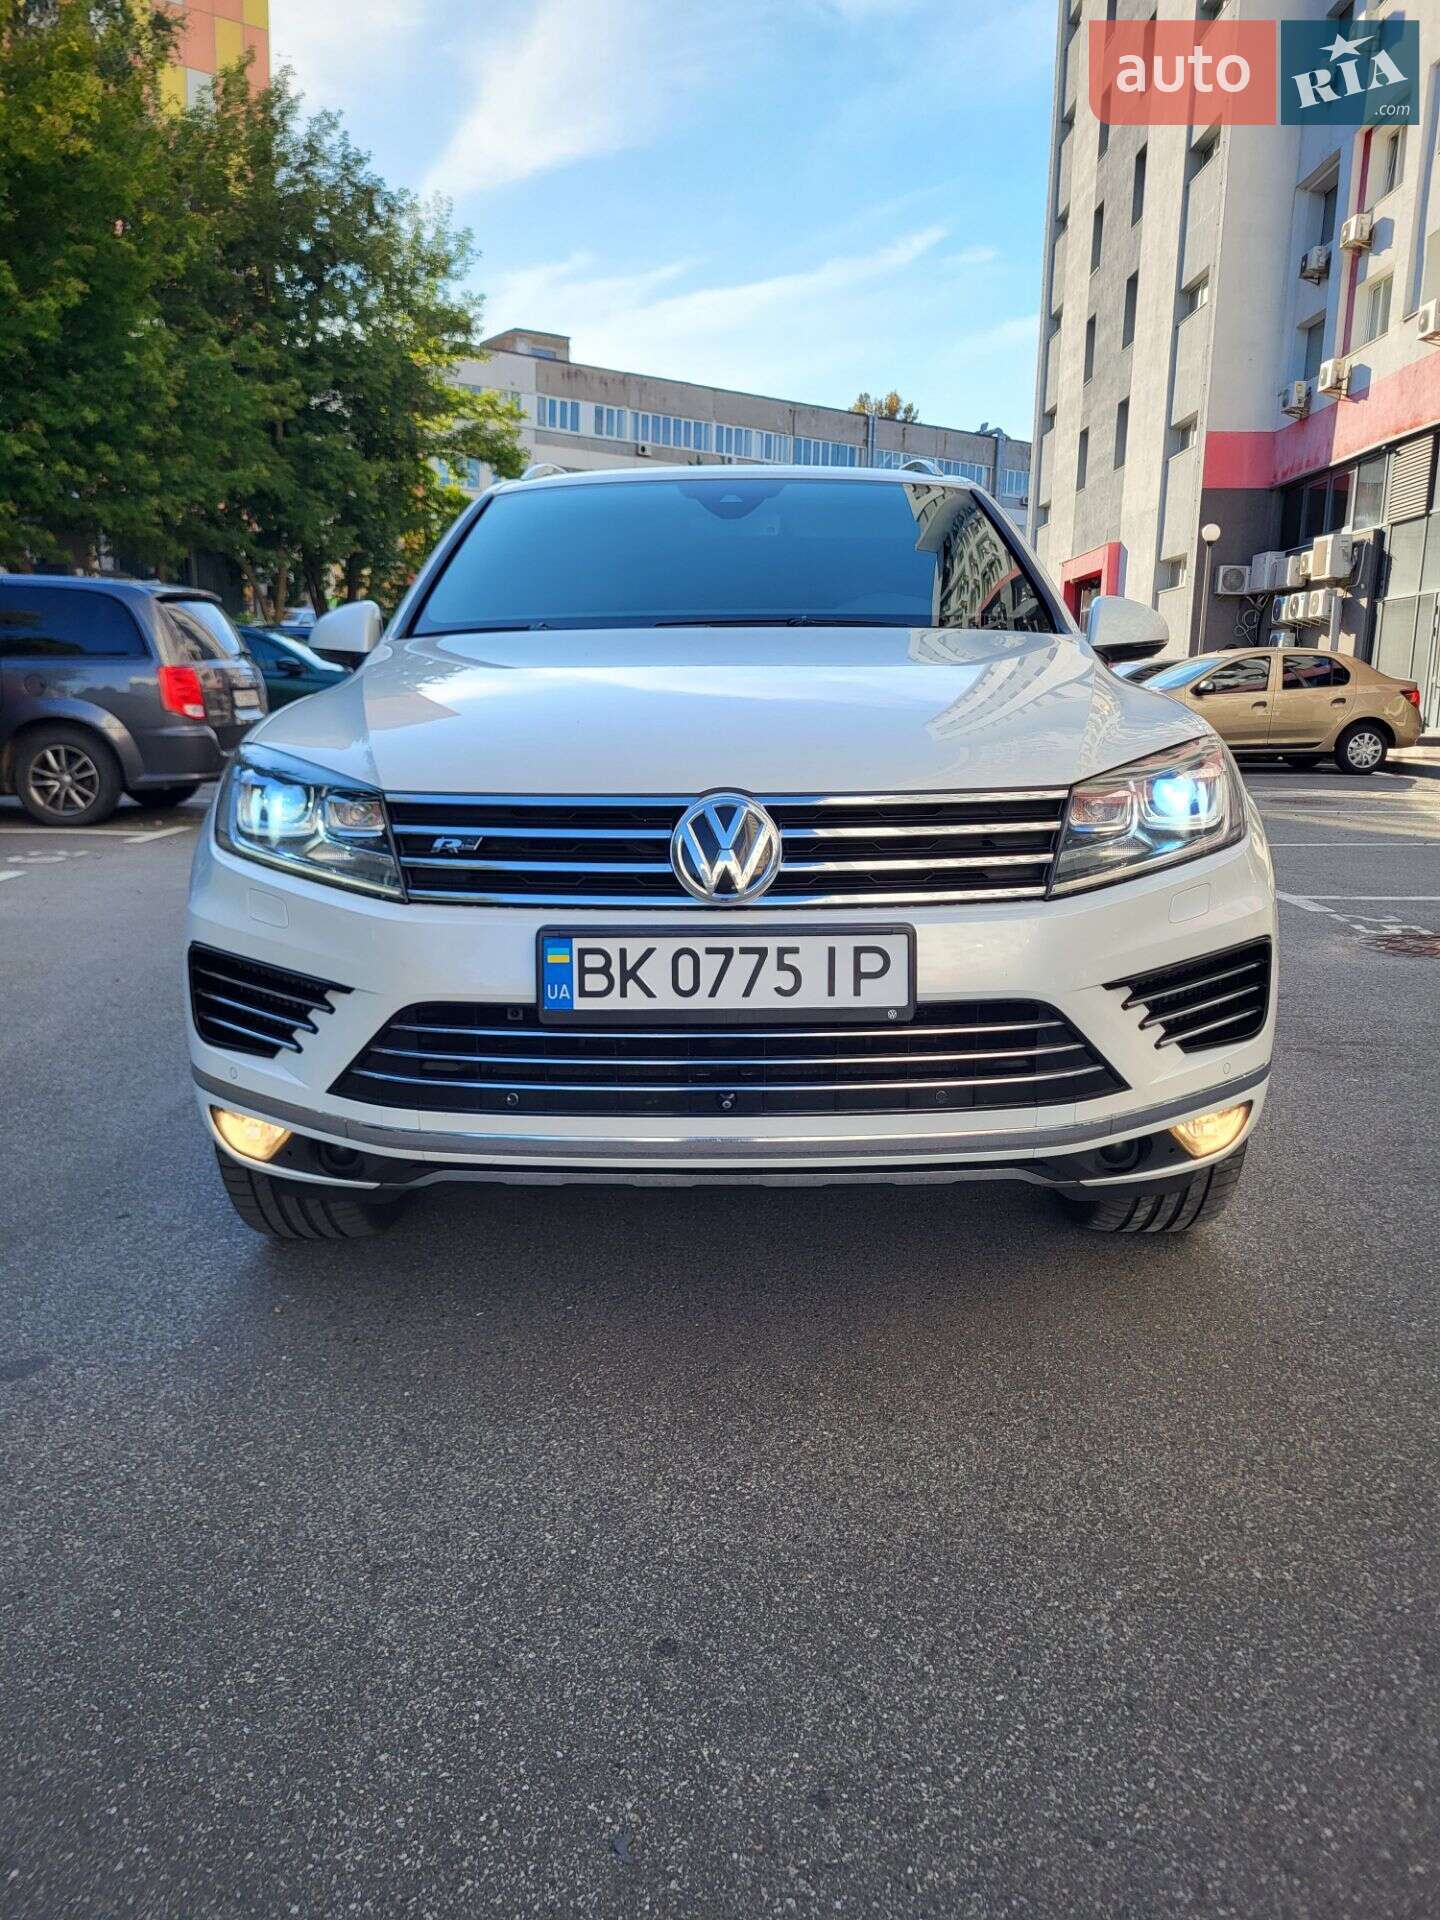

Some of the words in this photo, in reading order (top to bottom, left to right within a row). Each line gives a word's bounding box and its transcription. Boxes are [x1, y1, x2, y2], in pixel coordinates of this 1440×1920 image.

[577, 947, 657, 998] BK
[671, 946, 802, 998] 0775
[827, 946, 892, 997] IP
[547, 983, 570, 999] UA
